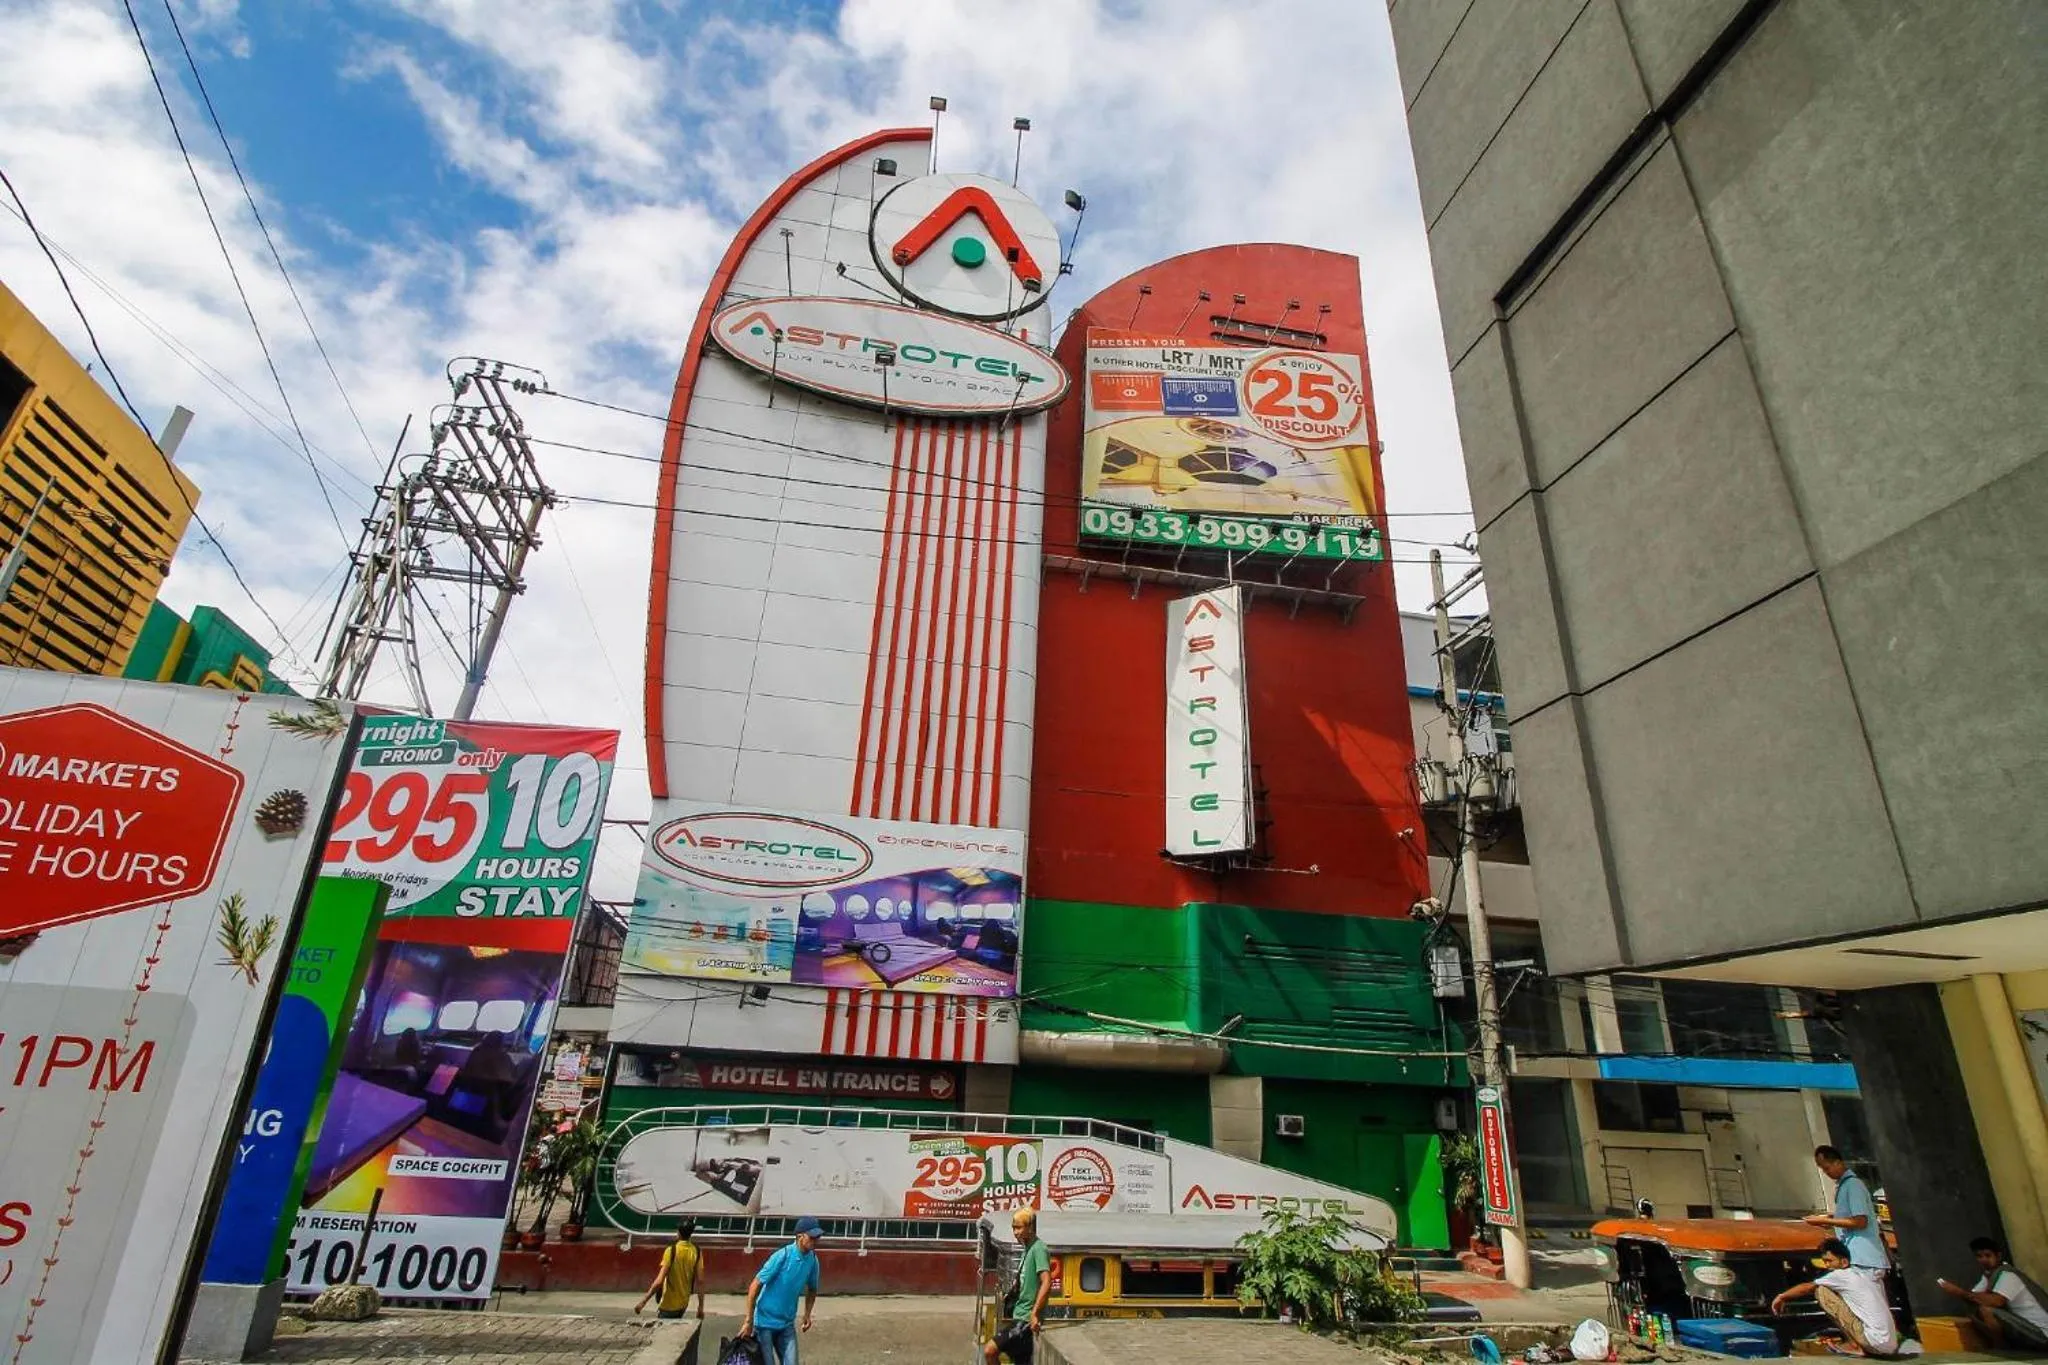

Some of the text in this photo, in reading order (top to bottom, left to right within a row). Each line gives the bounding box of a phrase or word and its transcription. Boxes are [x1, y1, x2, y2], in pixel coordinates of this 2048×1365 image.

[728, 310, 1046, 384] ASTROTEL
[1091, 338, 1187, 347] PRESENT YOUR
[1103, 357, 1134, 368] OTHER
[1135, 359, 1166, 371] HOTEL
[1166, 363, 1213, 376] DISCOUNT
[1215, 369, 1242, 379] CARD
[1161, 348, 1195, 365] LRT
[1209, 354, 1246, 371] MRT
[1290, 360, 1323, 372] enjoy
[1262, 417, 1348, 437] DISCOUNT
[1184, 598, 1222, 847] ASTROTEL
[379, 748, 443, 764] PROMO
[456, 747, 506, 772] only
[8, 752, 180, 792] MARKETS
[502, 752, 602, 852] 10
[321, 771, 491, 865] 295
[663, 827, 858, 863] ASTROTEL
[28, 843, 189, 887] HOURS
[474, 856, 582, 881] HOURS
[395, 872, 430, 887] Fridays
[455, 884, 581, 918] STAY
[711, 1065, 921, 1092] HOTEL ENTRANCE
[395, 1159, 502, 1175] SPACE COCKPIT
[911, 1156, 985, 1189] 295
[985, 1143, 1039, 1184] 10
[983, 1183, 1037, 1198] HOURS
[1182, 1184, 1365, 1219] ASTROTEL
[982, 1195, 1036, 1215] STAY
